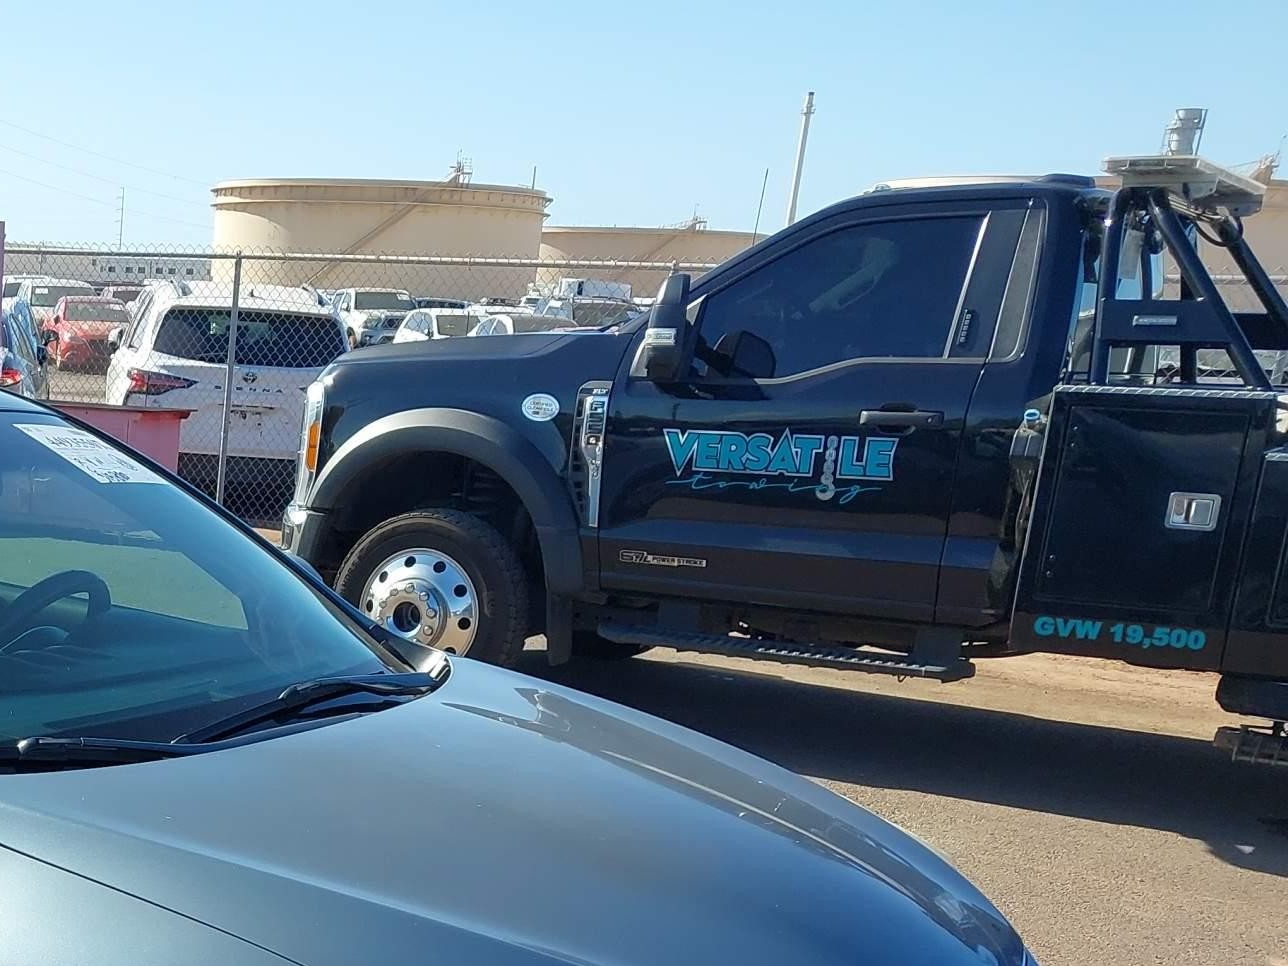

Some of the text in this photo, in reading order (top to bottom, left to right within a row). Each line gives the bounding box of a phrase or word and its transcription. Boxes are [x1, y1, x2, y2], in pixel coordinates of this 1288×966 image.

[214, 385, 283, 394] SENNA
[662, 427, 899, 481] VERSATILE
[1033, 616, 1206, 650] GVW 19,500
